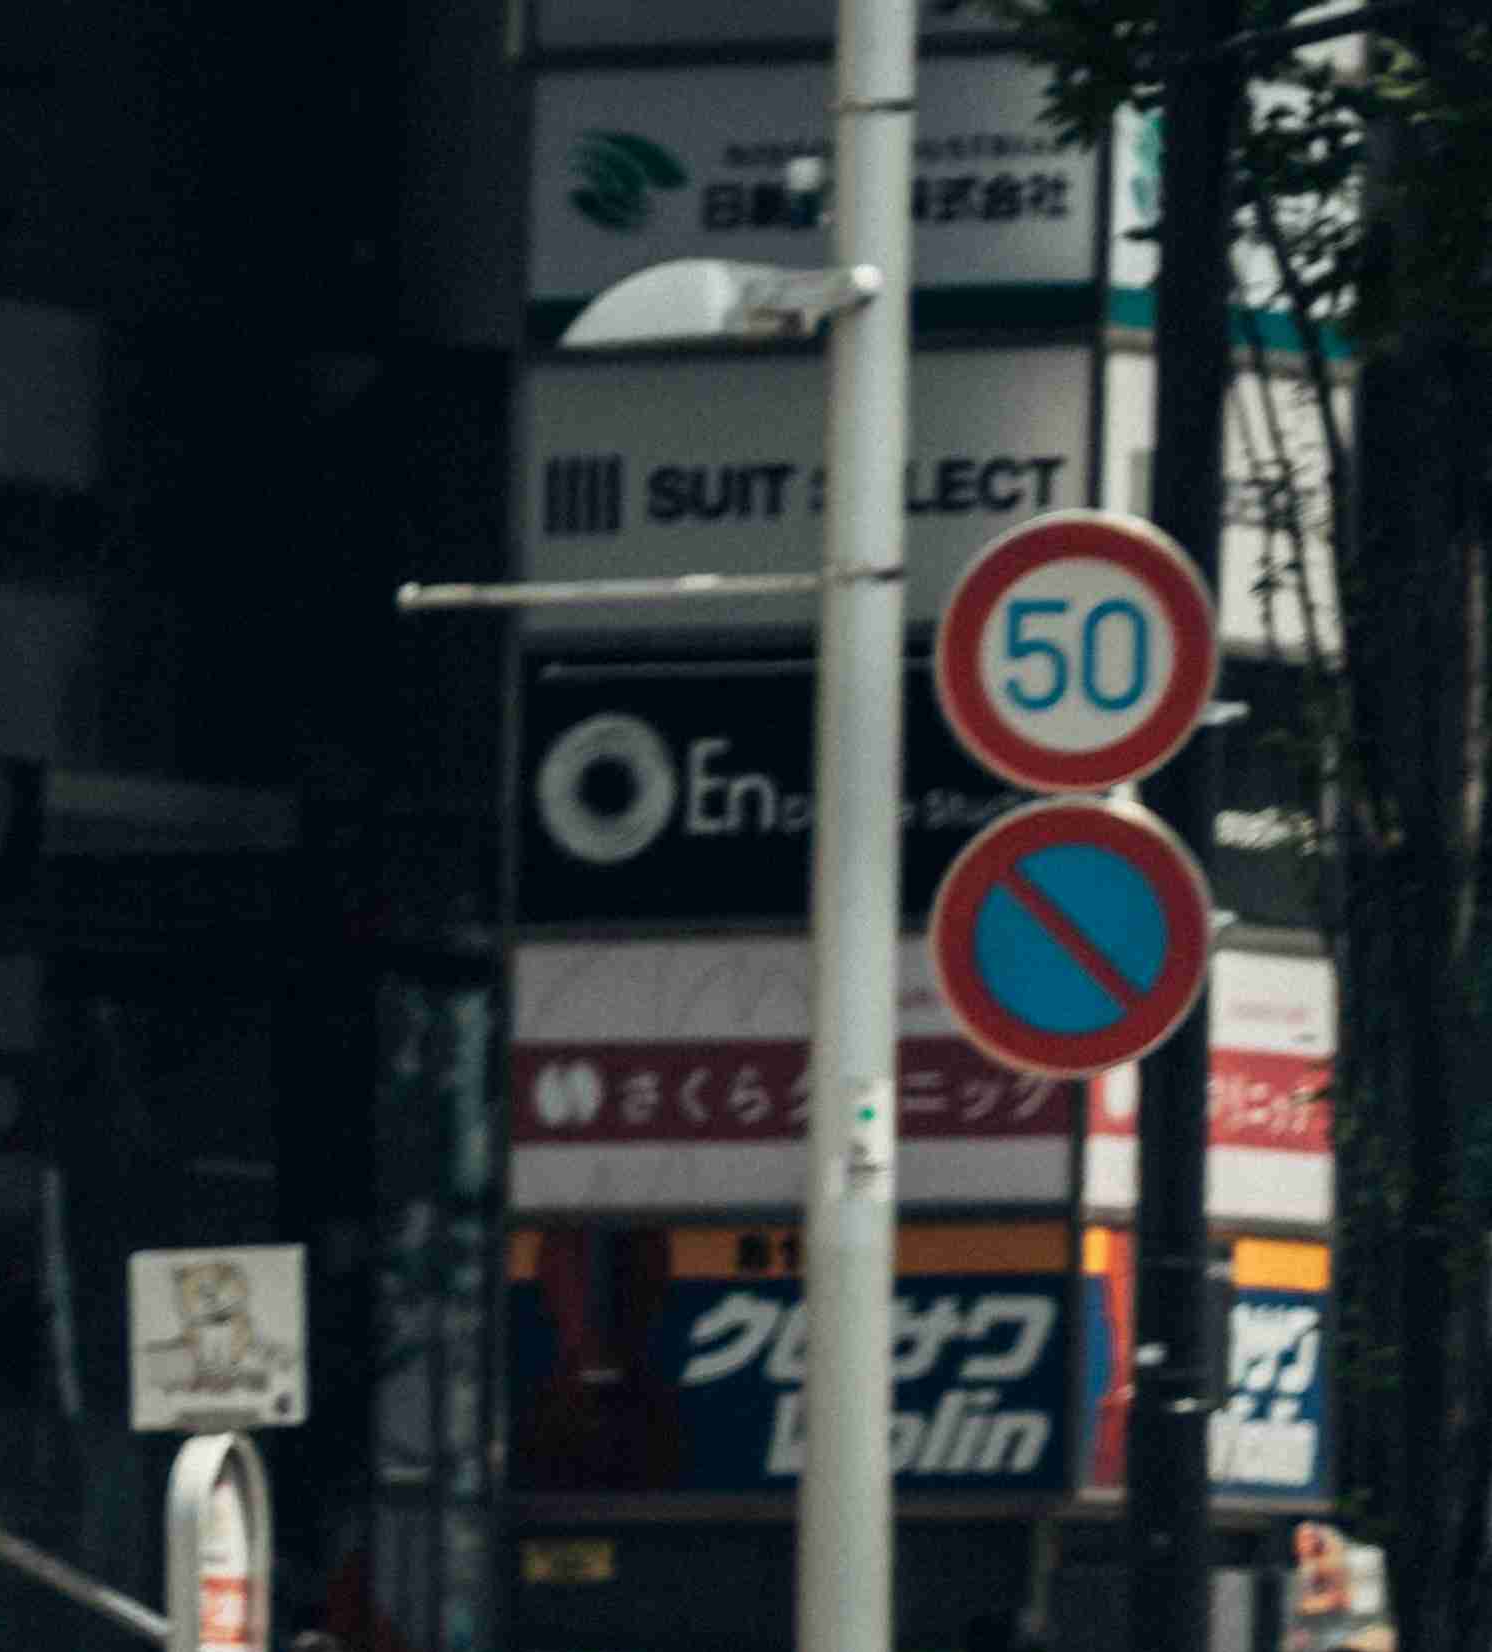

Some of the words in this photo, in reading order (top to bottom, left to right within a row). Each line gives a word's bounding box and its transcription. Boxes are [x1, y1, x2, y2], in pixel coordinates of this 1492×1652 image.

[645, 463, 798, 522] SUIT
[810, 456, 1067, 514] LECT
[1005, 597, 1147, 711] 50
[619, 1066, 1052, 1124] さくらニック
